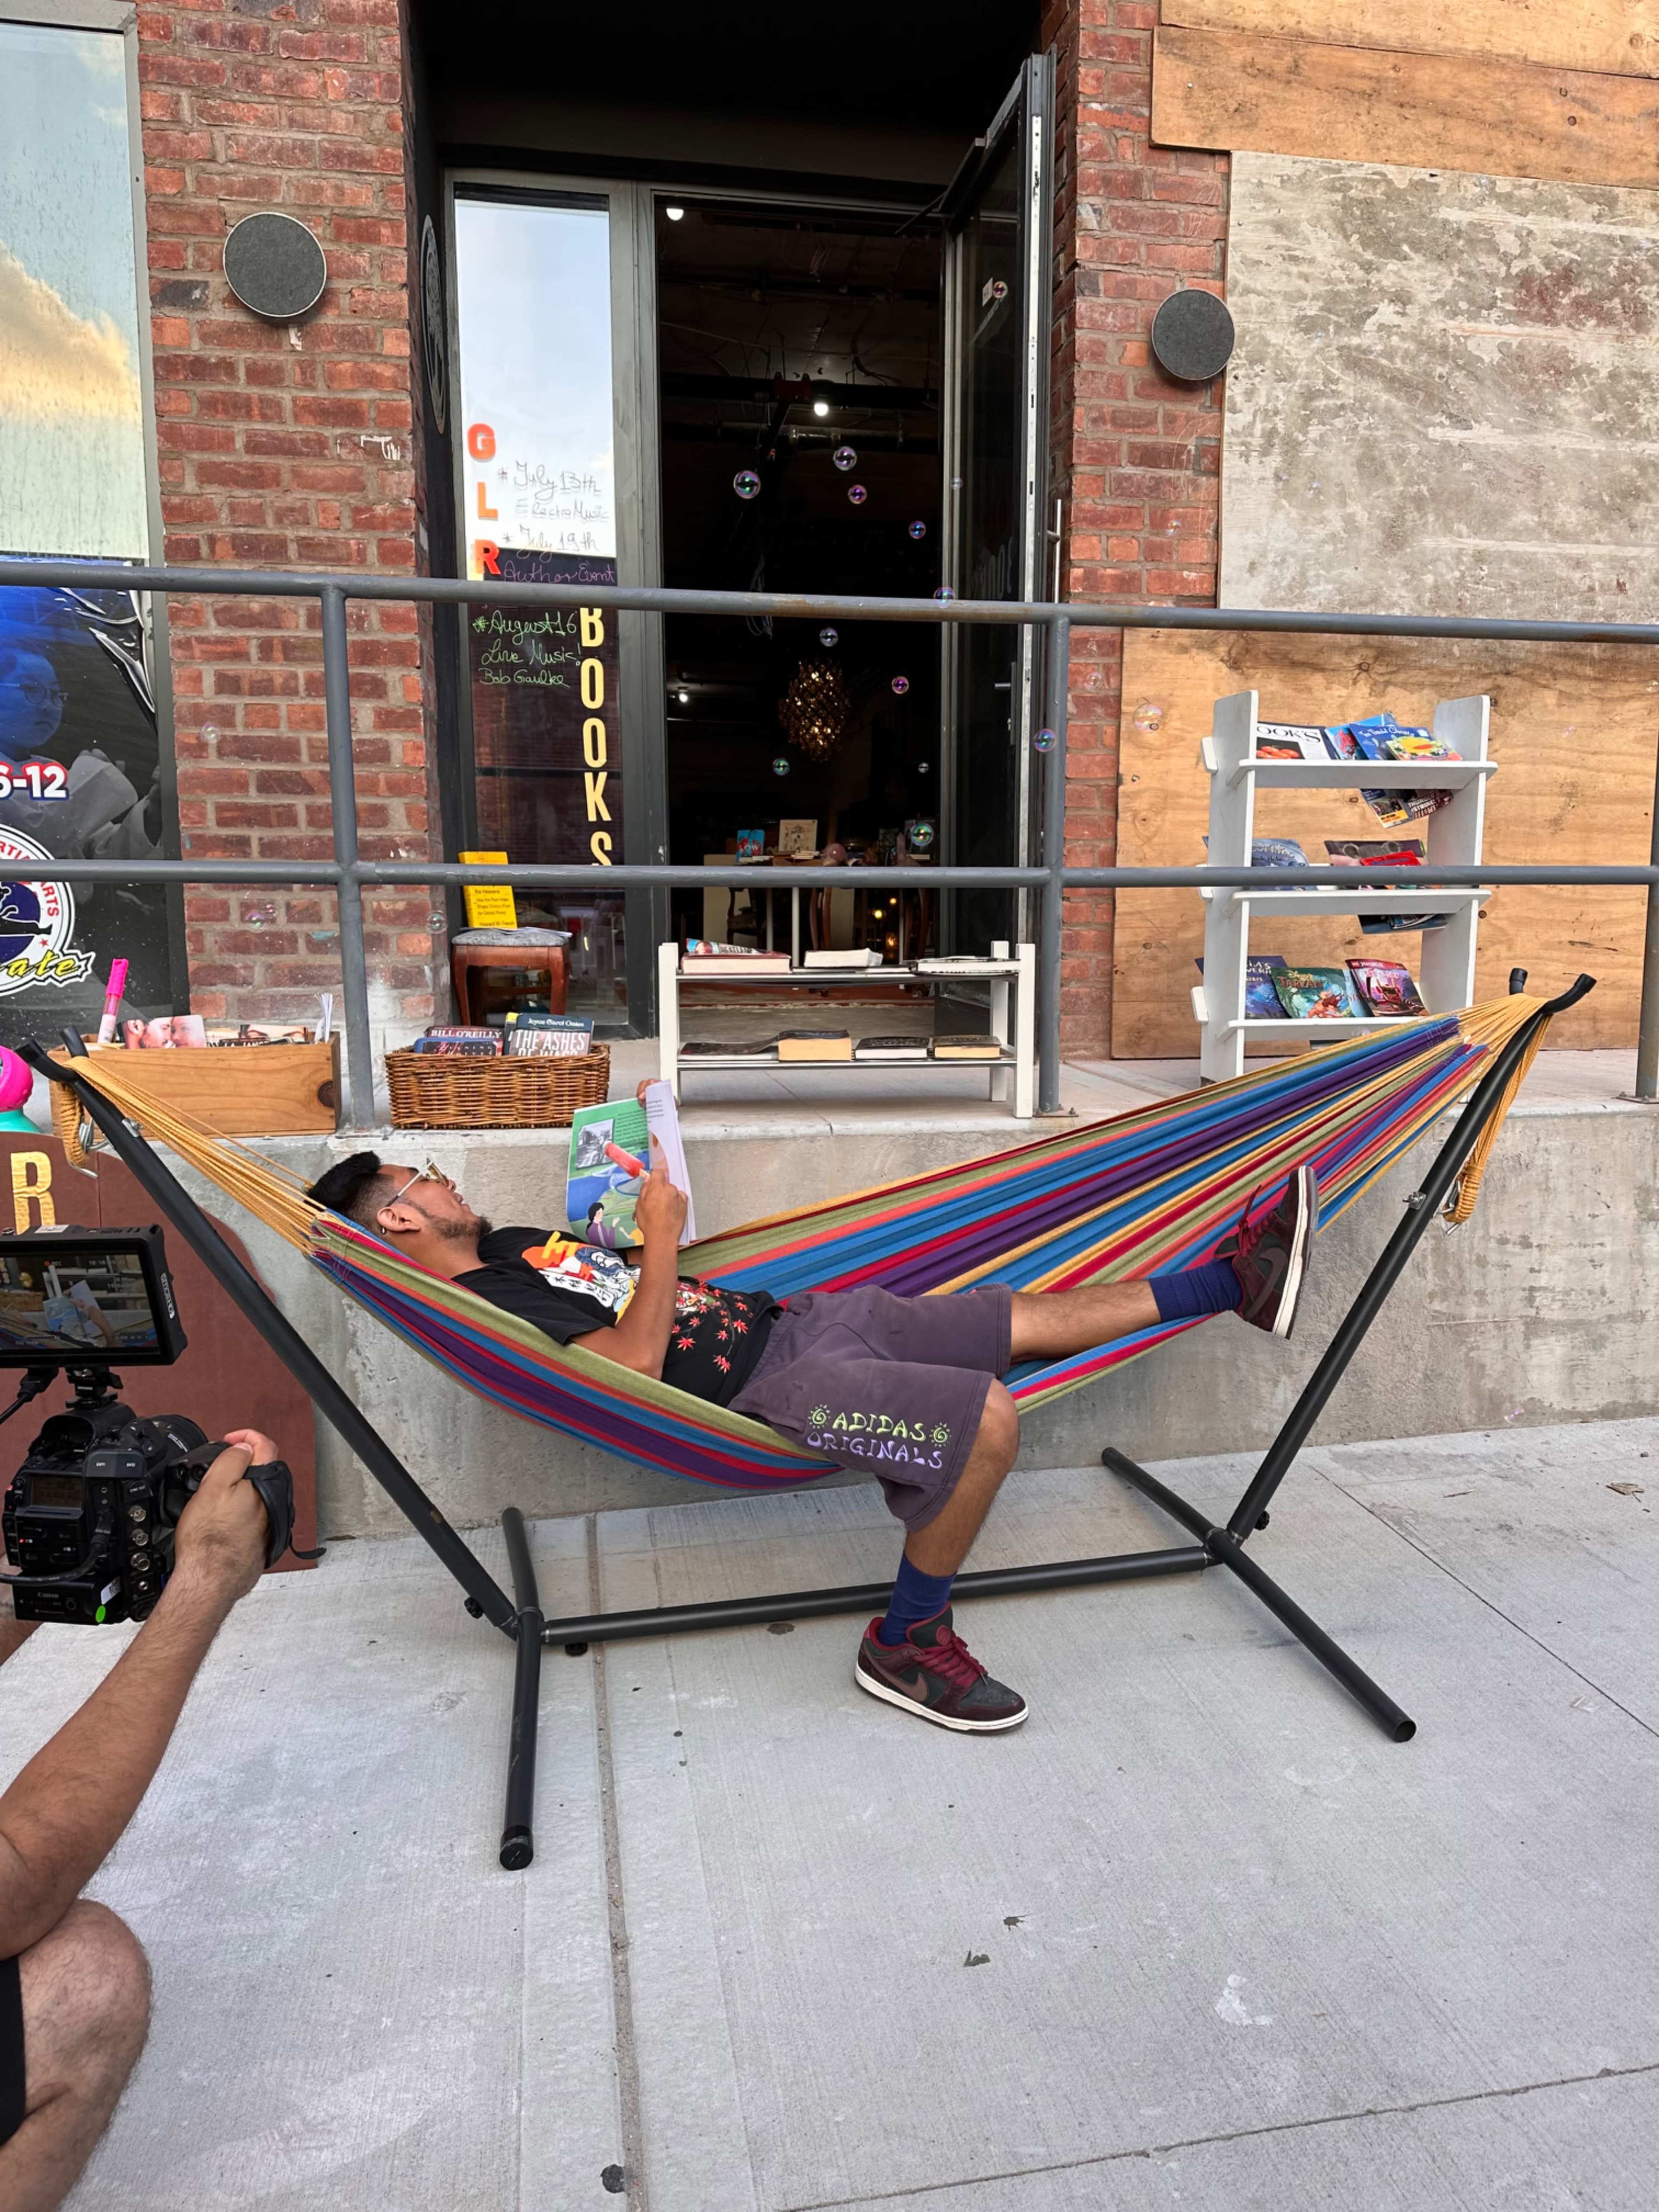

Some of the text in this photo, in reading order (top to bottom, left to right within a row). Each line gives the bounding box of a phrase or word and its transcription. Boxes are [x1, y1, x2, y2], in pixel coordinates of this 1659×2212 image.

[515, 460, 601, 500] July 13th
[573, 499, 609, 519] Music
[516, 524, 599, 563] July 19th
[503, 560, 615, 583] Author Event
[488, 610, 577, 645] August 16
[481, 639, 581, 666] Live Music!
[478, 668, 511, 686] Bob
[579, 607, 612, 866] BOOKS
[41, 882, 60, 916] RTS
[0, 949, 81, 978] ate
[456, 1030, 502, 1039] O'REILLY
[515, 1029, 538, 1049] THE
[542, 1031, 586, 1051] ASHES
[833, 1411, 926, 1442] ADIDAS
[807, 1431, 943, 1469] ORIGINALS
